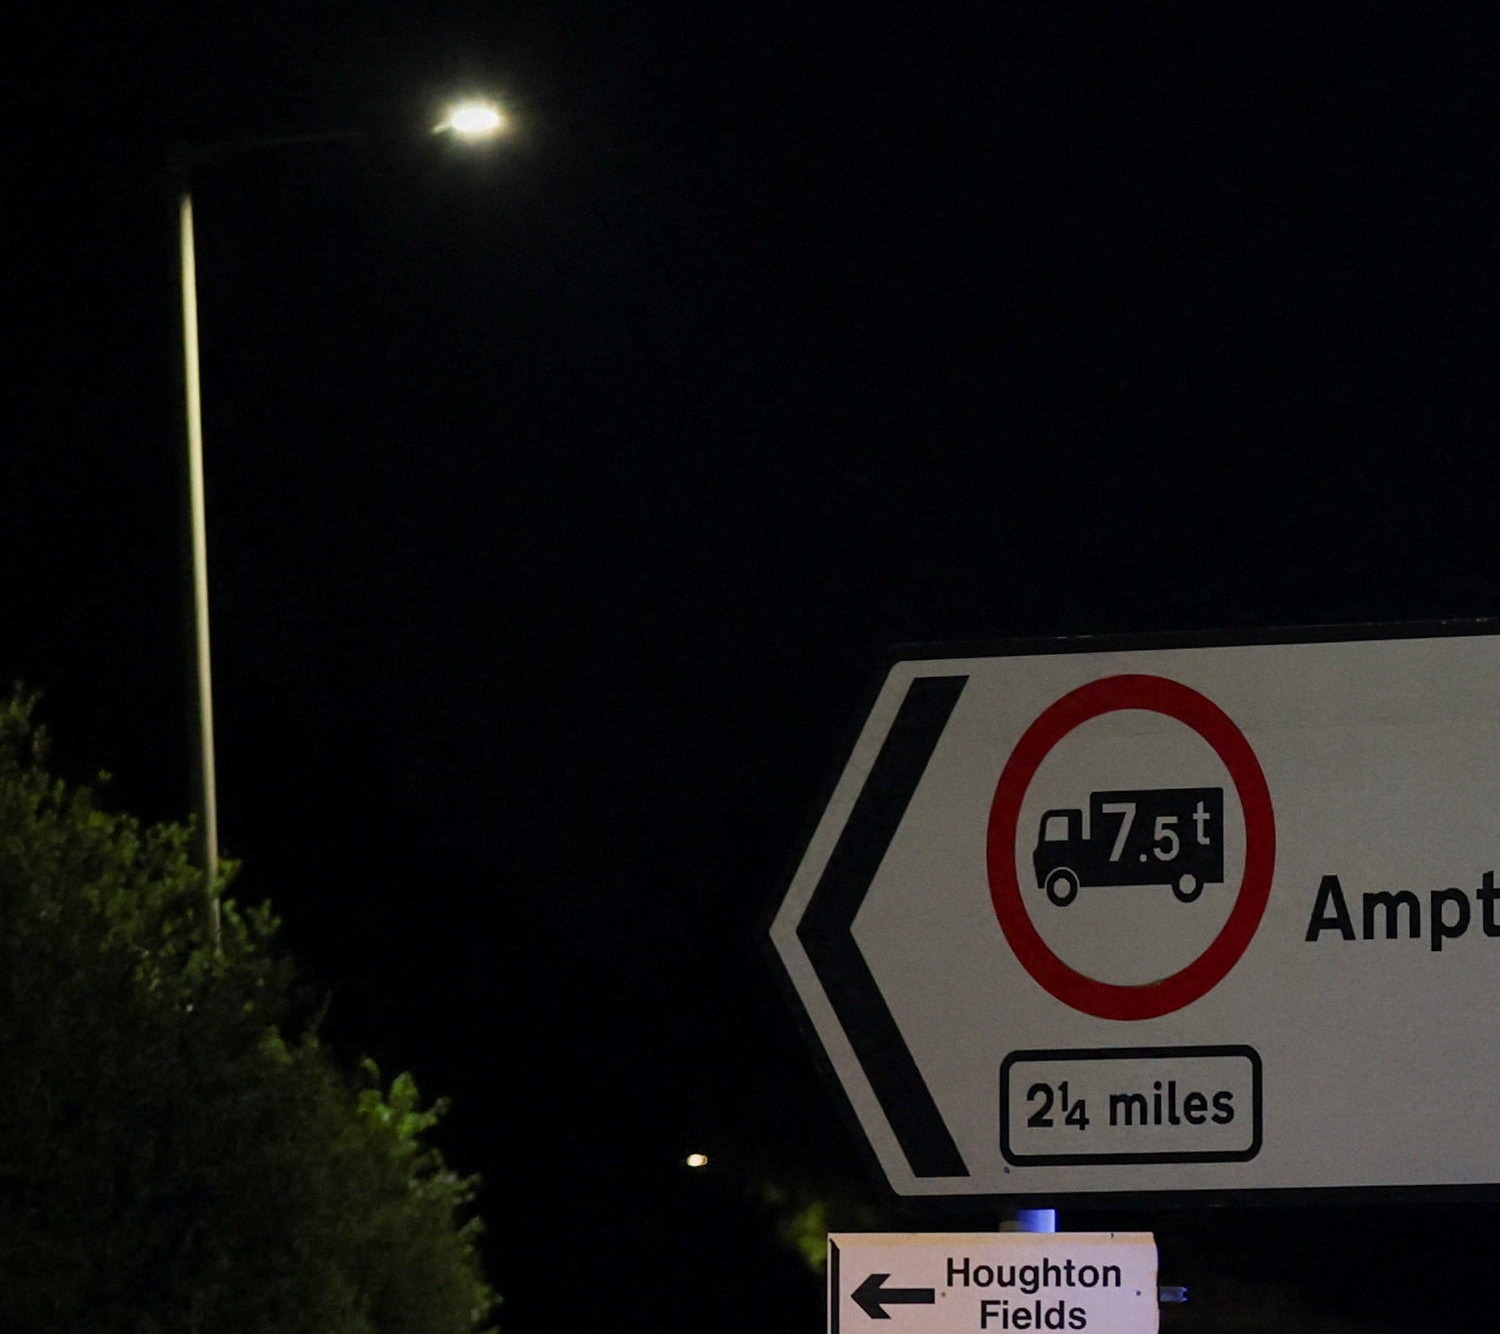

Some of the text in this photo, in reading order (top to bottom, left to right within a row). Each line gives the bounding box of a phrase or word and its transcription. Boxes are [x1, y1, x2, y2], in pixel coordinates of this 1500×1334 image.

[1109, 1079, 1235, 1127] miles
[946, 1257, 1122, 1295] Houghton
[980, 1299, 1087, 1330] Fields
